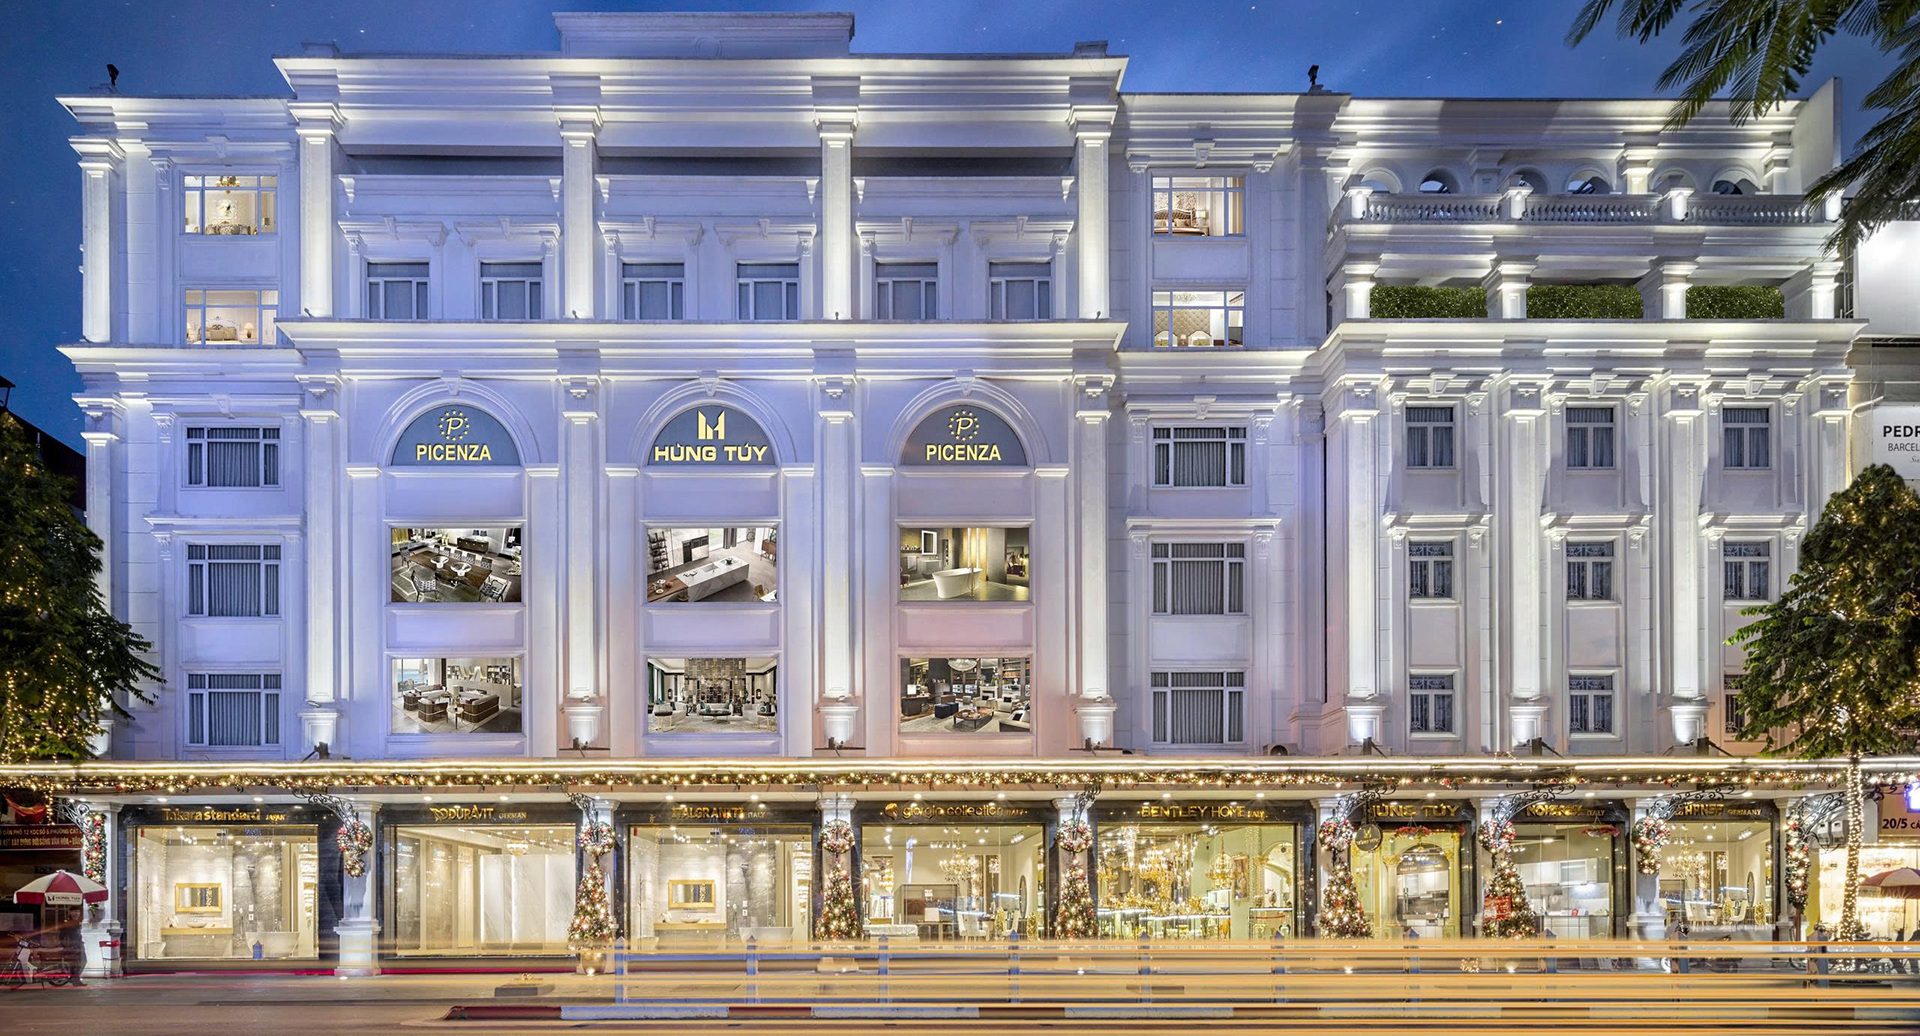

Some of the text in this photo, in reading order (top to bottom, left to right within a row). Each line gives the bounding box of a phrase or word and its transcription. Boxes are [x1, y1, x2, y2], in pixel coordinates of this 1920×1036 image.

[416, 444, 492, 461] PICENZA
[654, 443, 768, 462] HÙNG TÚY
[926, 444, 1002, 461] PICENZA
[204, 808, 261, 820] standard
[448, 805, 494, 820] DURAVIT
[1141, 806, 1208, 818] BENTLEY
[1211, 806, 1246, 818] HOME
[1421, 803, 1460, 817] TÚY
[1882, 818, 1908, 829] 20/5
